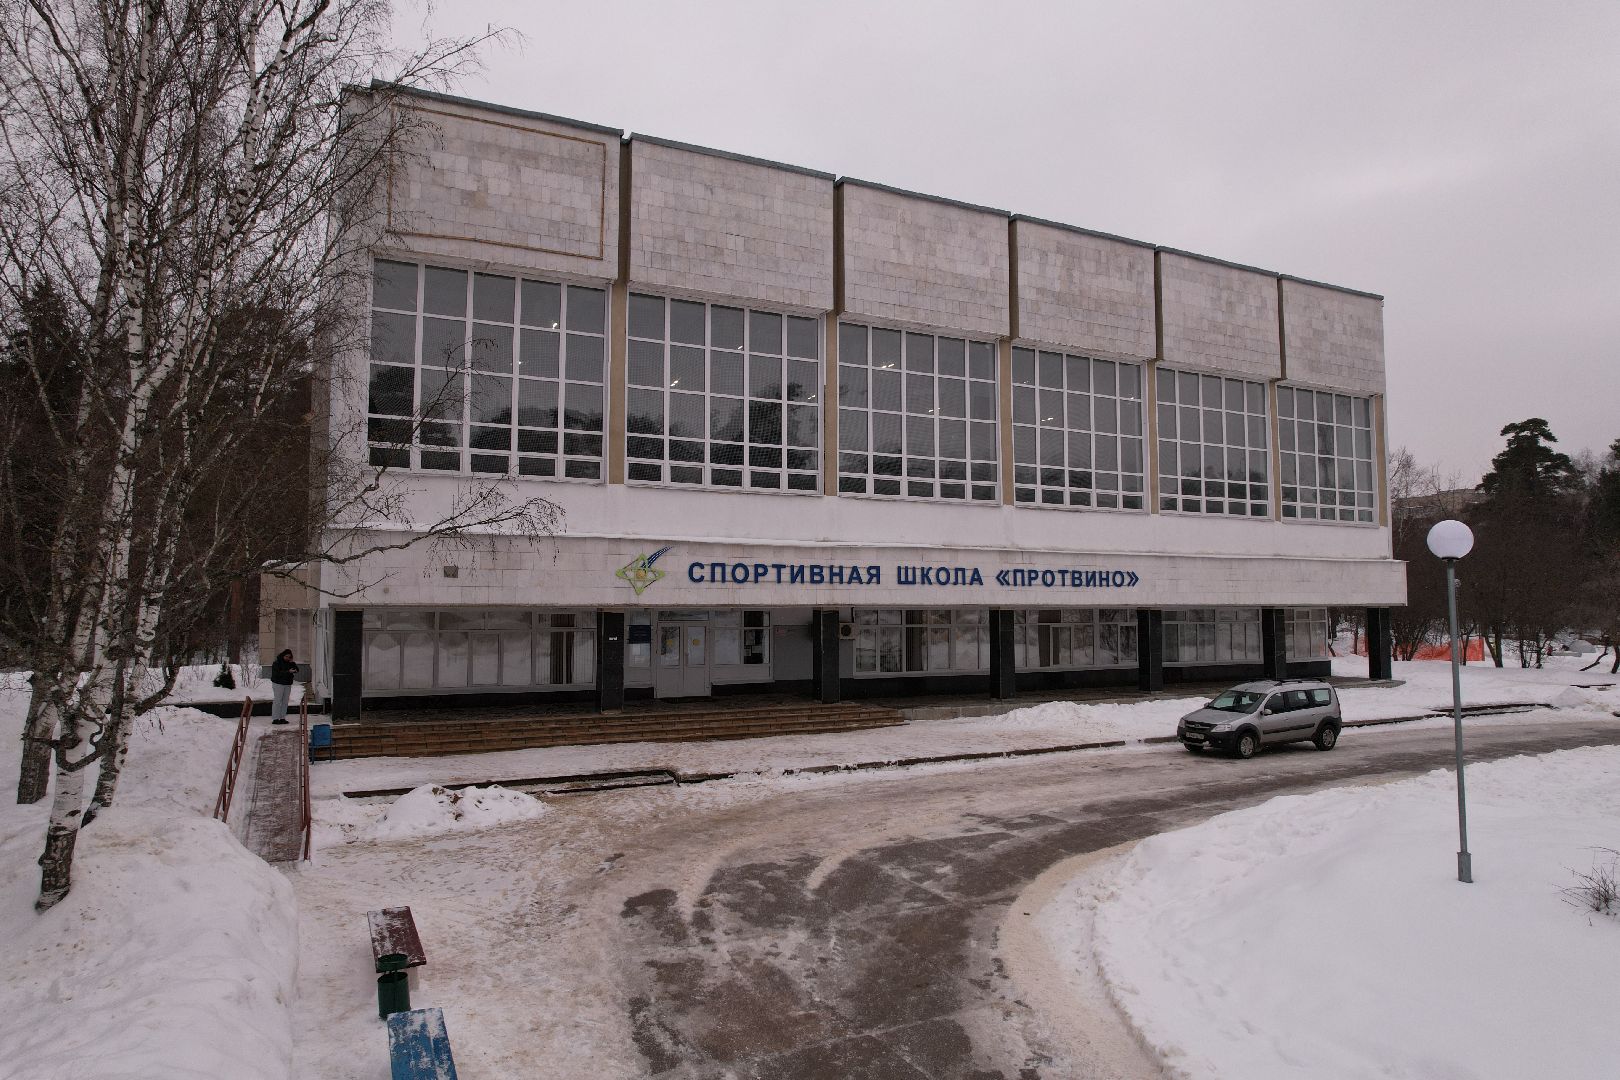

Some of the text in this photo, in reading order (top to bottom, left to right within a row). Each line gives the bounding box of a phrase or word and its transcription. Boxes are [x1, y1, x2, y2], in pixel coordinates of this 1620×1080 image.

[688, 562, 1139, 588] СПОРТИВНАЯ ШКОЛА «ПРОТВИНО»
